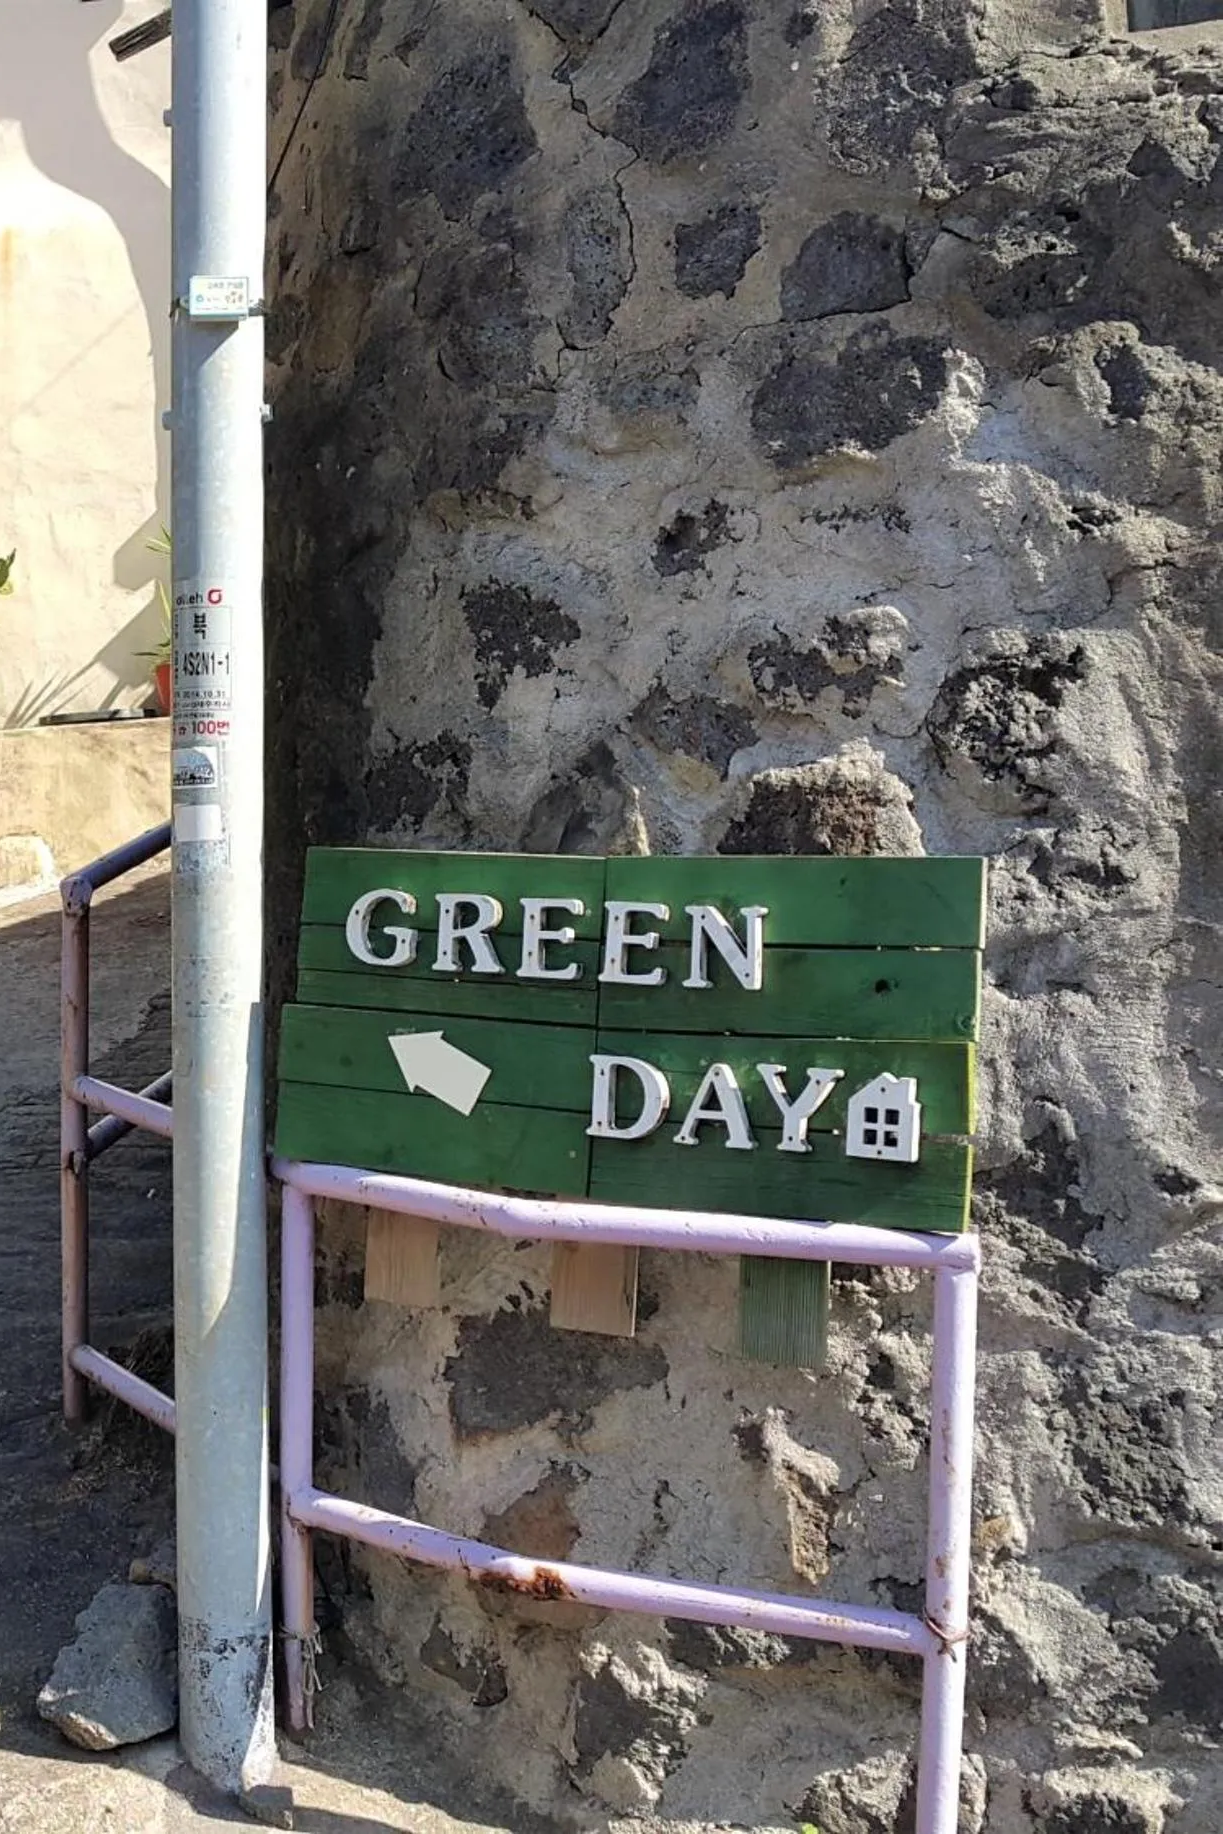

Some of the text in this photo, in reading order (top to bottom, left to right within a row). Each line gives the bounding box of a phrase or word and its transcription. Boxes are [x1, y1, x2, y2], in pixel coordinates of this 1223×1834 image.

[192, 612, 208, 640] 북
[345, 888, 769, 991] GREEN
[586, 1053, 845, 1154] DAY
